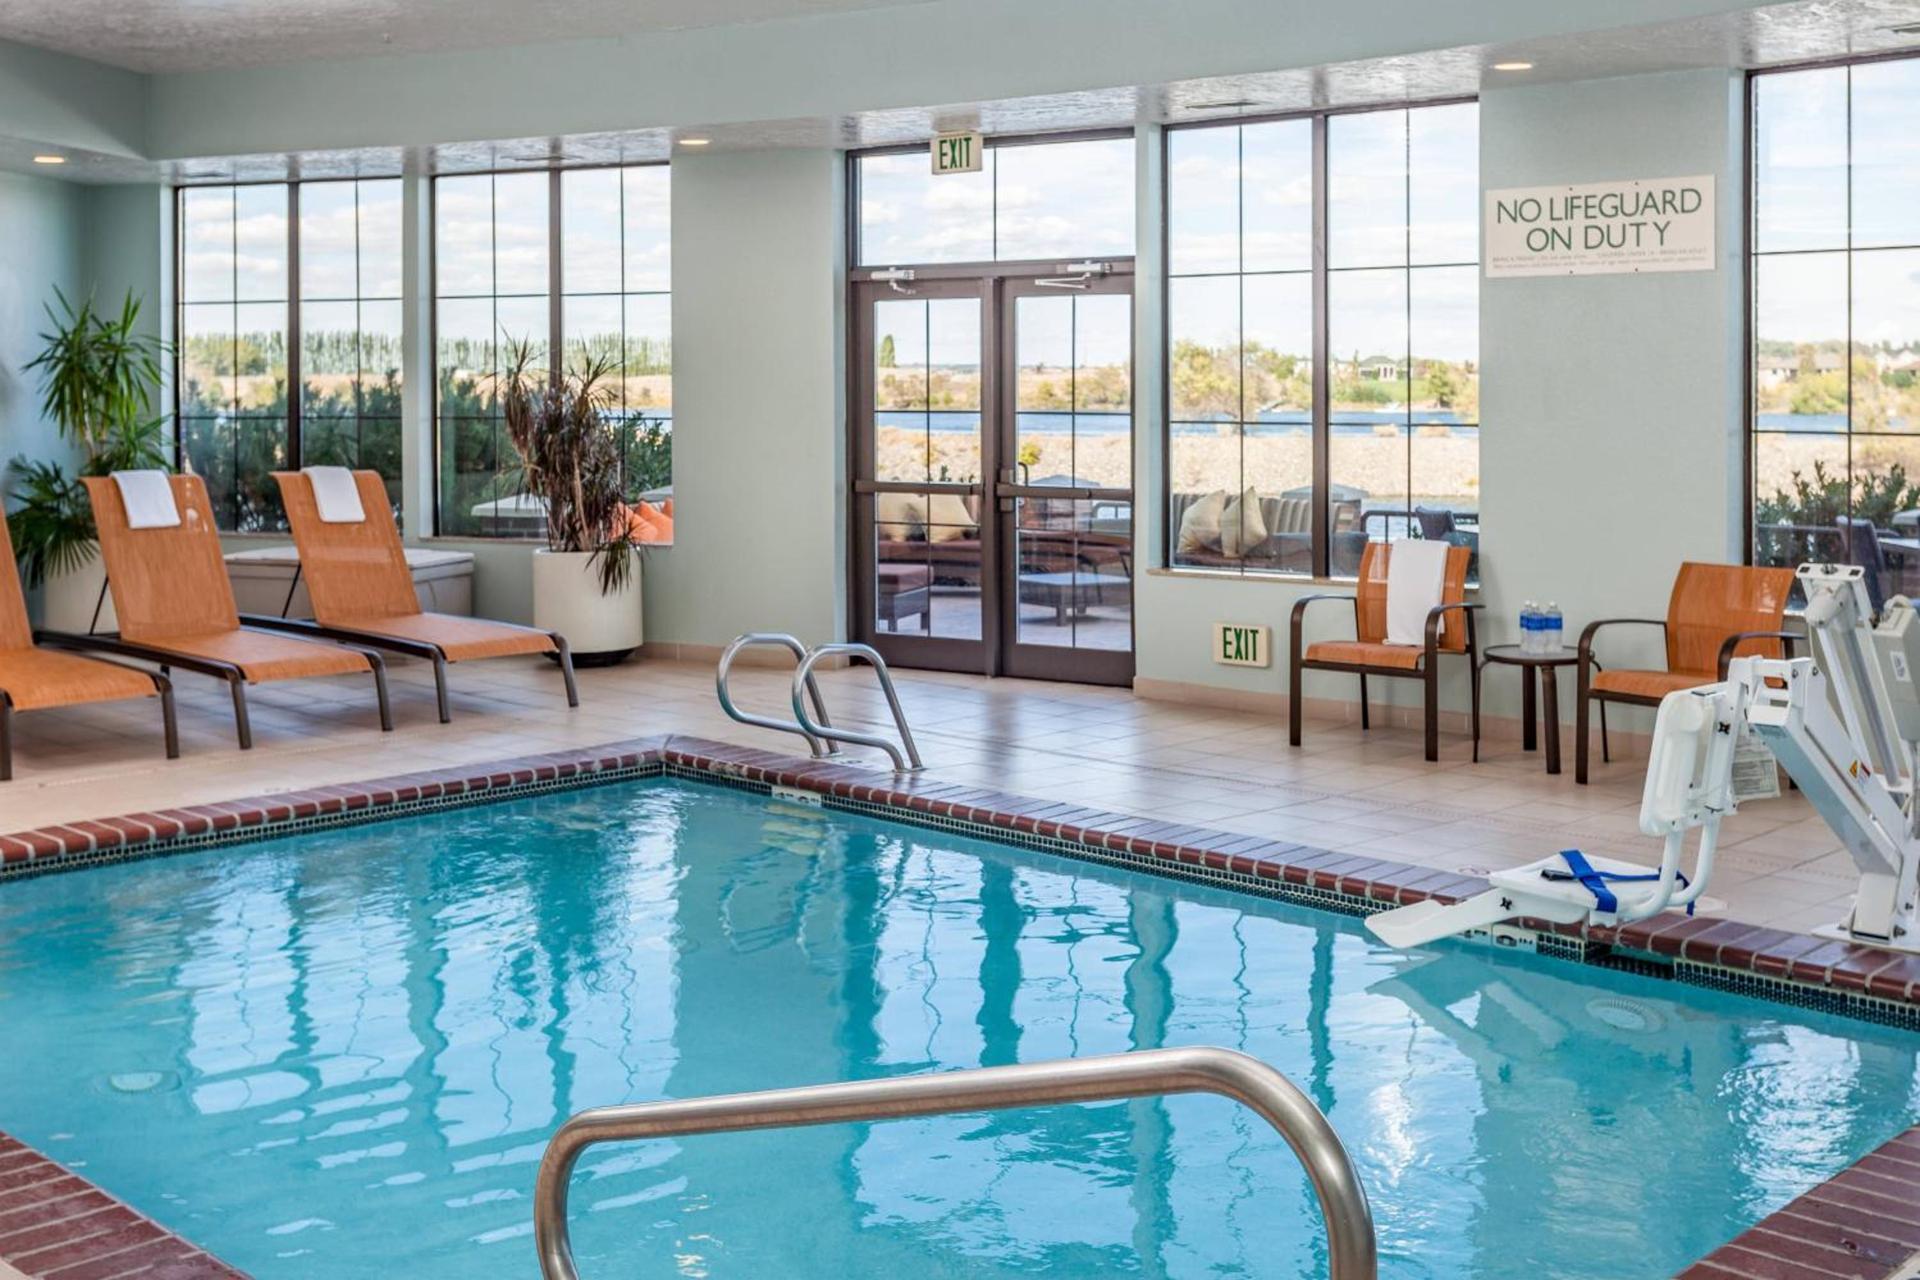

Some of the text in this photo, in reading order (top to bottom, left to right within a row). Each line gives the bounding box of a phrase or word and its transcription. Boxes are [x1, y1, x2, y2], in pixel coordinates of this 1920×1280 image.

[939, 137, 972, 170] EXIT
[1497, 188, 1702, 224] NO LIFEGUARD
[1526, 220, 1671, 252] ON DUTY
[1223, 627, 1259, 661] EXIT
